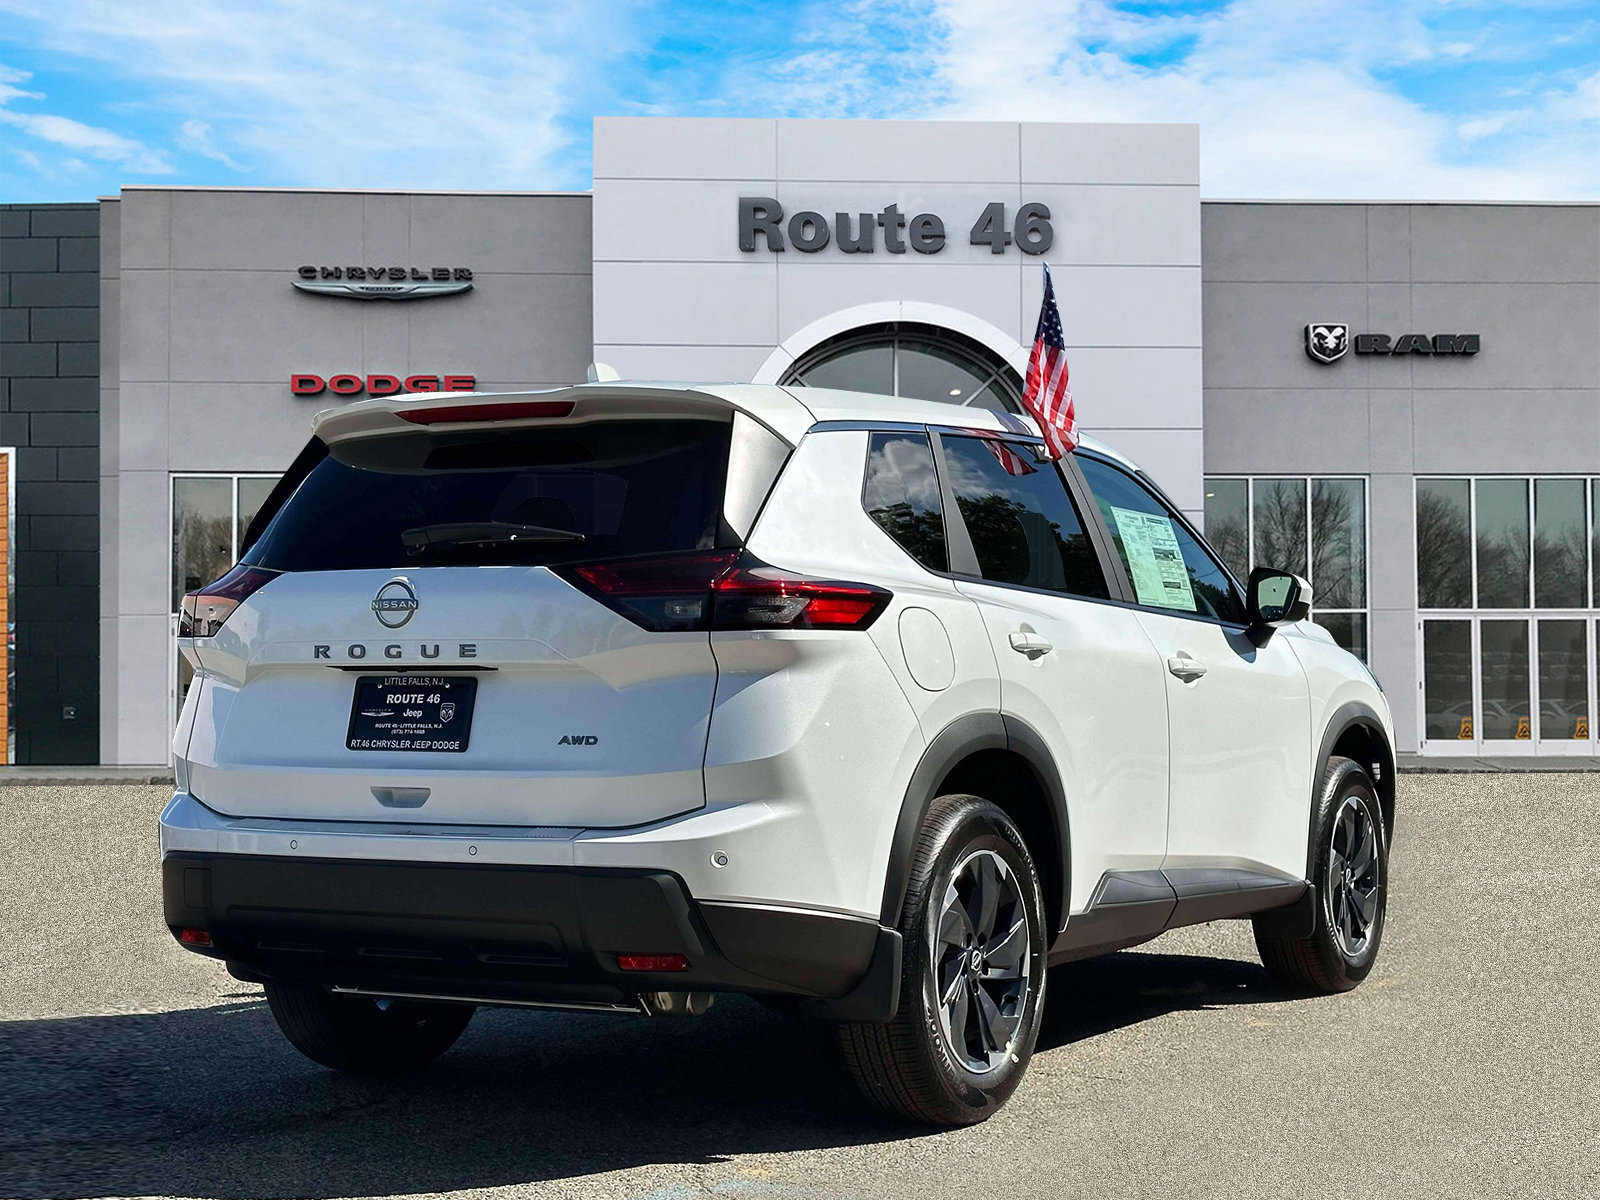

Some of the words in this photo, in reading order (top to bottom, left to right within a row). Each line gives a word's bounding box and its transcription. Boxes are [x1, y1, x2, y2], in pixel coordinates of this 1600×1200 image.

[738, 197, 945, 255] Route
[969, 202, 1054, 255] 46
[298, 266, 473, 280] CHRYSLER
[1354, 334, 1480, 355] RAM
[291, 374, 476, 395] DODGE
[372, 600, 418, 610] NISSAN
[314, 644, 477, 659] ROGUE
[384, 677, 408, 686] LITTLE
[408, 677, 431, 687] FALLS,
[386, 693, 425, 704] ROUTE
[426, 693, 441, 704] 46
[402, 708, 423, 719] Jeep
[350, 739, 370, 748] RT.46
[370, 739, 411, 748] CHRYSLER
[411, 740, 431, 749] JEEP
[432, 741, 460, 750] DODGE
[558, 735, 598, 746] AWD
